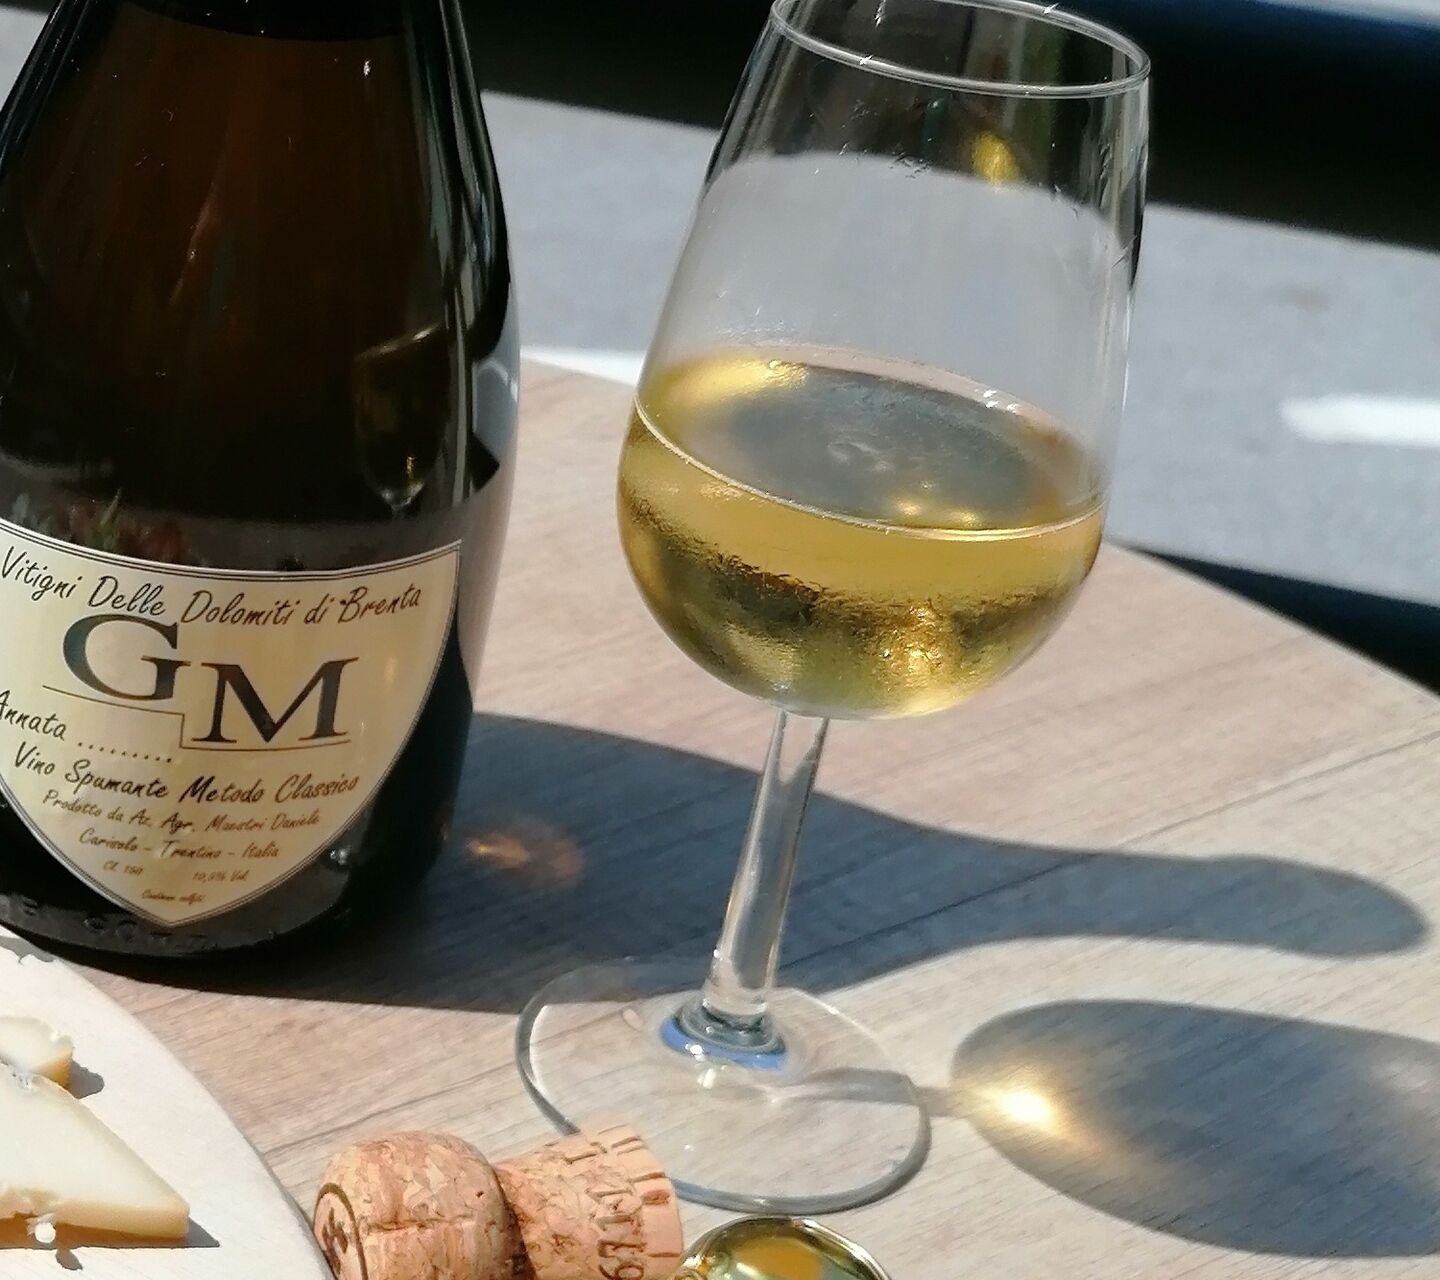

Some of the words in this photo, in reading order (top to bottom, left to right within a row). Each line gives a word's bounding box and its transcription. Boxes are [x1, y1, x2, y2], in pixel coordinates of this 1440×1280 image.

[1, 546, 83, 601] Vitigni
[88, 576, 166, 616] Delle
[180, 590, 300, 626] Dolomiti
[304, 593, 335, 624] di
[338, 583, 422, 623] Brenta
[62, 614, 359, 743] GM
[14, 741, 56, 775] Vino
[65, 759, 170, 799] Spumante
[178, 776, 265, 803] Metodo
[274, 773, 360, 803] Classico
[43, 789, 102, 818] Prodotto
[107, 806, 124, 822] da
[269, 808, 321, 831] Daniele
[79, 827, 140, 852] Carisolo
[160, 839, 222, 858] Trentino
[241, 840, 280, 859] Italia
